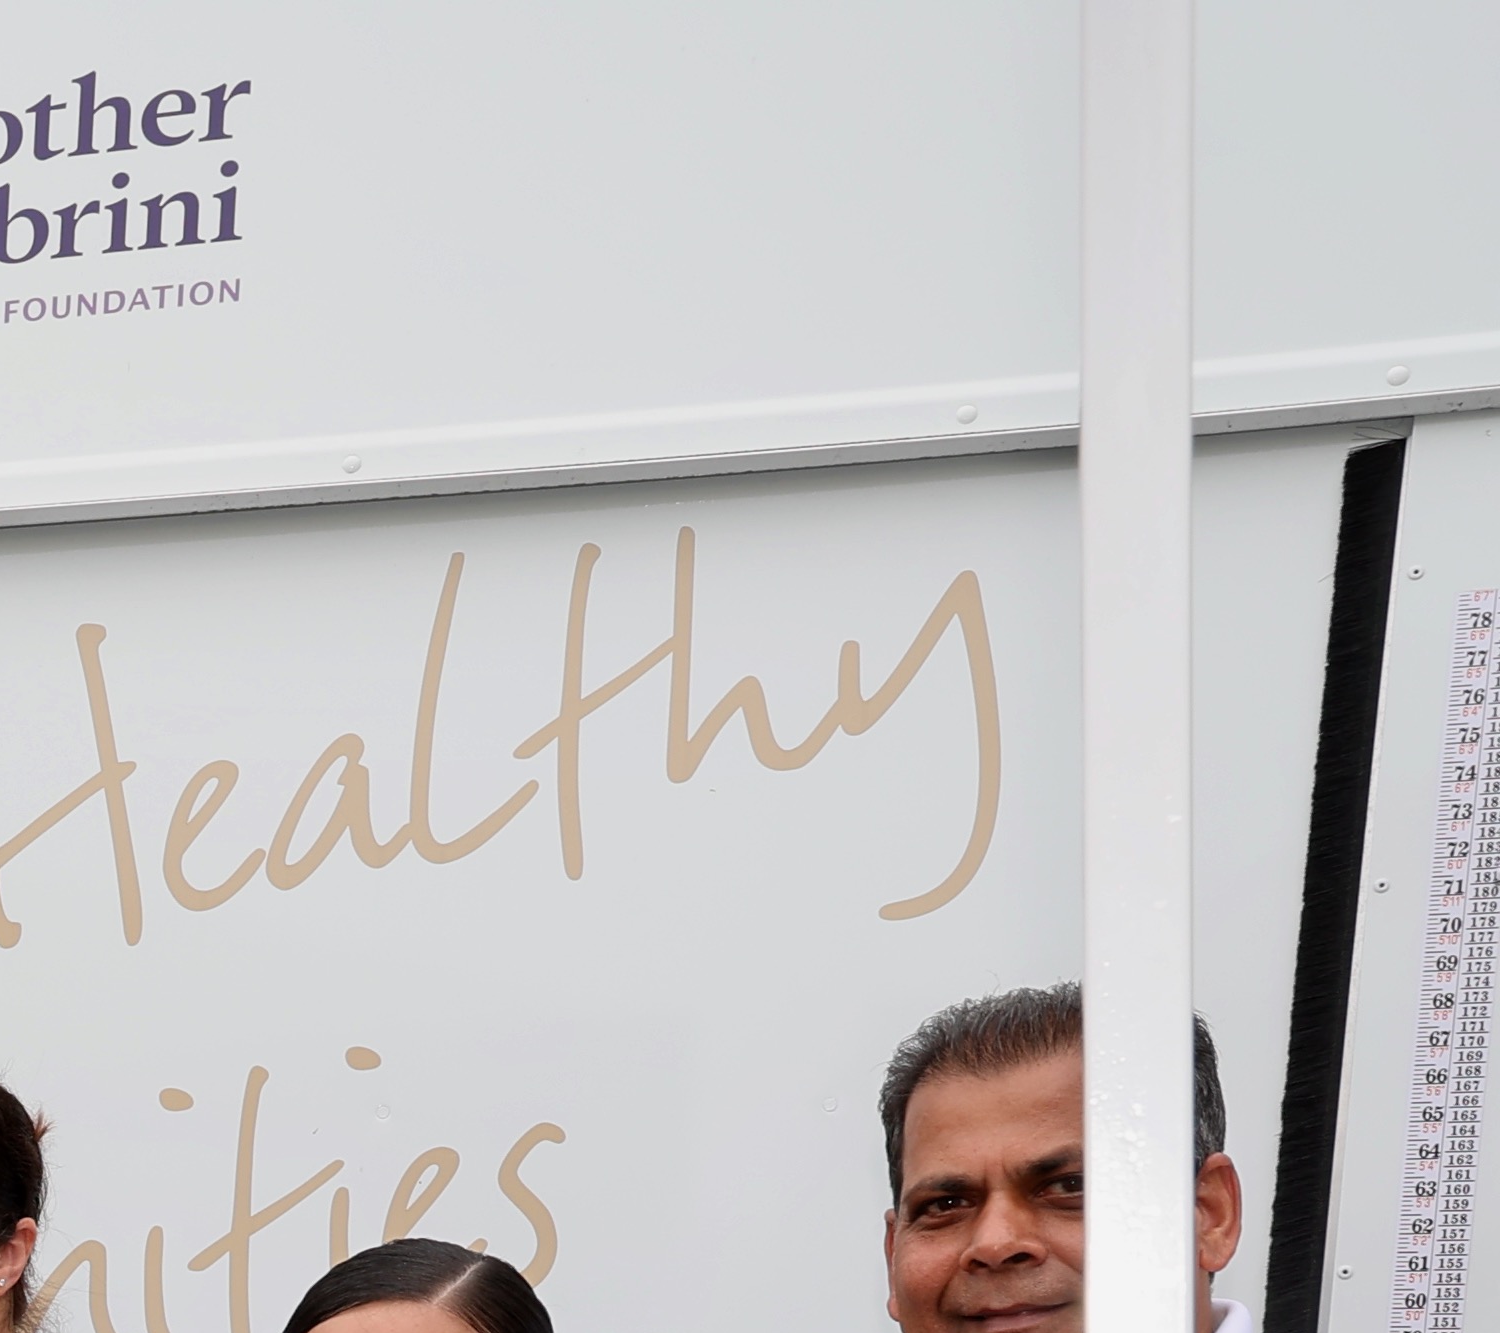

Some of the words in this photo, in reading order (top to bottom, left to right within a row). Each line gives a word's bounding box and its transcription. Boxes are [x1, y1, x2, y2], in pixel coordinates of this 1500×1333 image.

[4, 279, 242, 326] FOUNDATION
[1470, 612, 1492, 628] 78
[1467, 651, 1487, 666] 77
[1463, 689, 1484, 704] 76
[1460, 728, 1480, 743] 75
[1456, 766, 1476, 781] 74
[1452, 804, 1472, 819] 73
[1448, 842, 1469, 857] 72
[1444, 880, 1465, 895] 71
[1441, 918, 1461, 933] 70
[1436, 956, 1457, 971] 69
[1433, 993, 1454, 1008] 68
[1430, 1031, 1450, 1046] 67
[1426, 1069, 1447, 1084] 66
[1422, 1106, 1444, 1121] 65
[1419, 1144, 1440, 1159] 64
[1416, 1182, 1436, 1196] 63
[1412, 1219, 1433, 1234] 62
[1409, 1256, 1429, 1271] 61
[1405, 1293, 1426, 1308] 60
